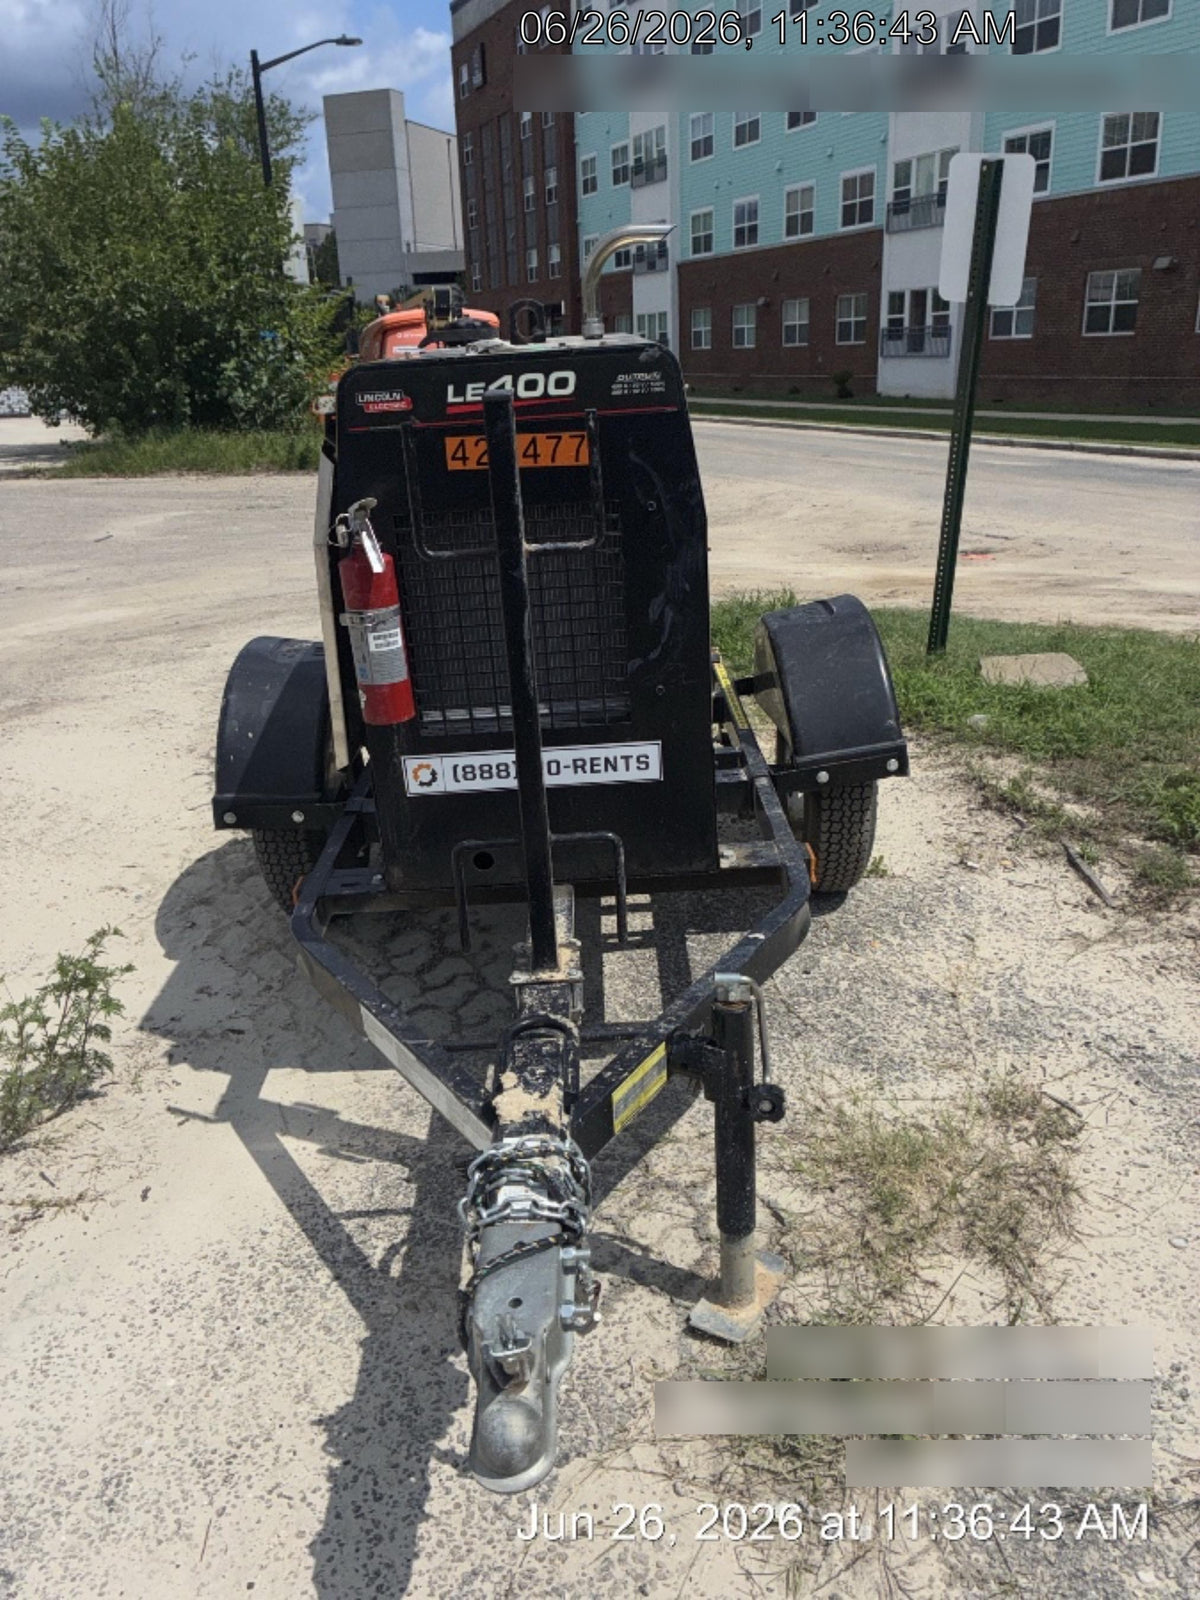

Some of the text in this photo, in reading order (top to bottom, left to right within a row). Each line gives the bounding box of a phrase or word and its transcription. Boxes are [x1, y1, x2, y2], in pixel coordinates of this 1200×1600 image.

[358, 391, 401, 403] LINCOLN
[447, 371, 577, 403] LE400
[451, 433, 586, 467] 42477
